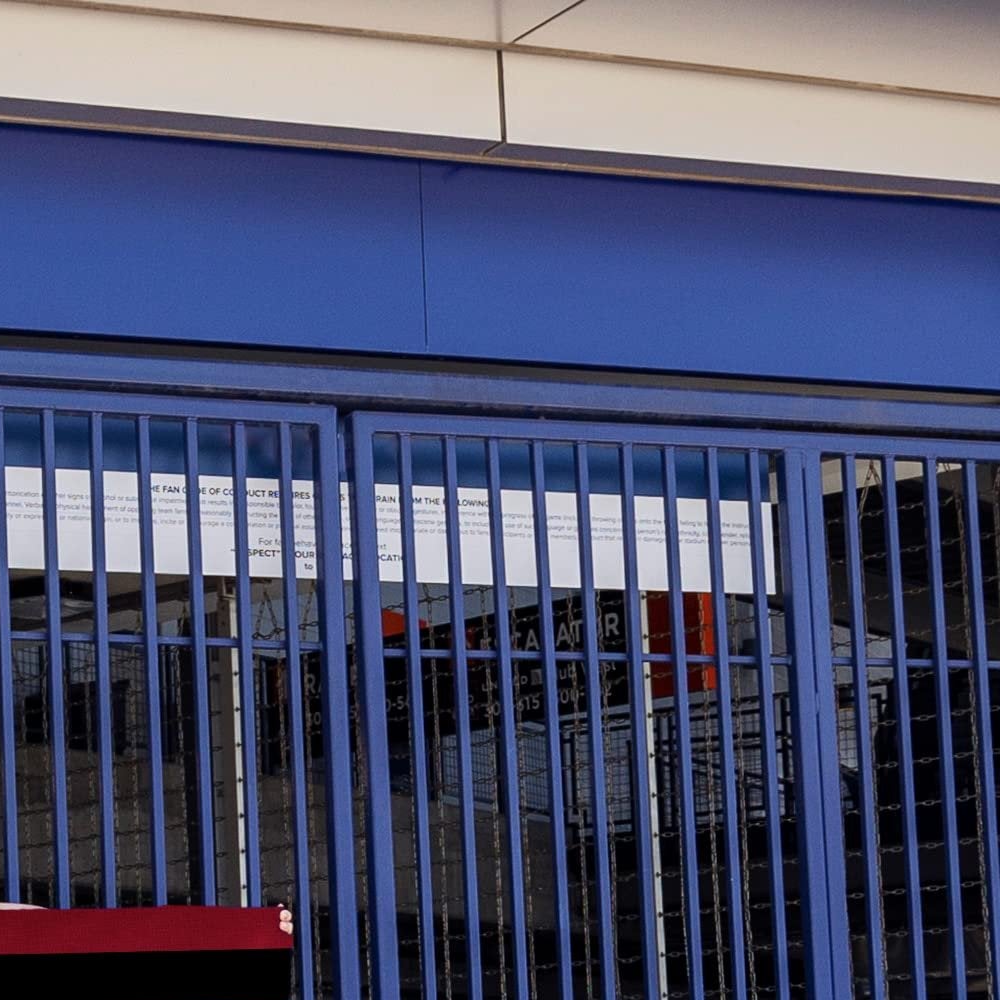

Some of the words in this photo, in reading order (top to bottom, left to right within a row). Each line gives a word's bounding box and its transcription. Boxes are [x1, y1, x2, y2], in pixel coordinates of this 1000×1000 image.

[163, 486, 180, 494] FAN
[209, 487, 221, 496] OF
[425, 498, 441, 506] THE
[304, 563, 314, 571] to
